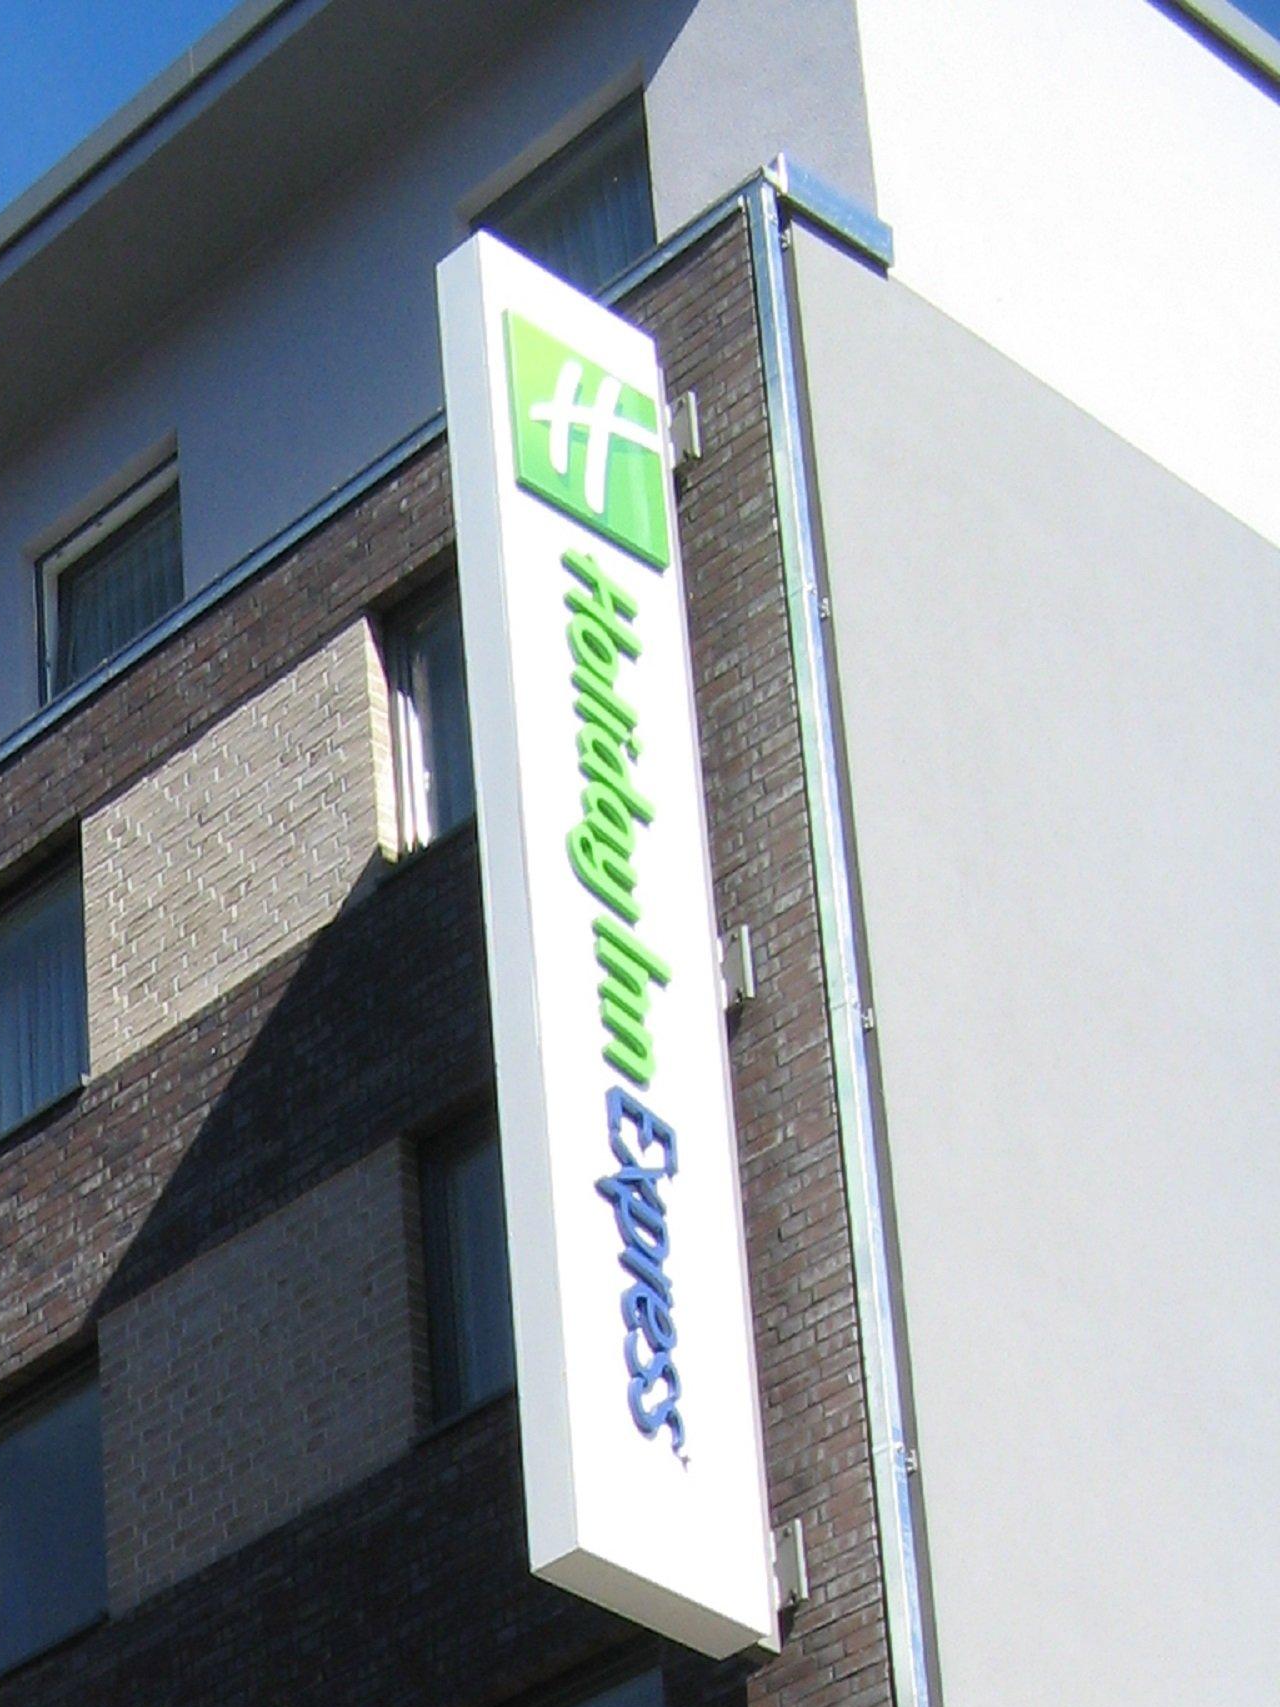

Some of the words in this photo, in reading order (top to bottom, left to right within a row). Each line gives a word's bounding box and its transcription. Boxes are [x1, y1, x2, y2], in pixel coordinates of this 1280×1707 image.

[560, 547, 656, 928] Holiday
[591, 914, 674, 1091] Inn
[594, 1084, 686, 1458] Express
